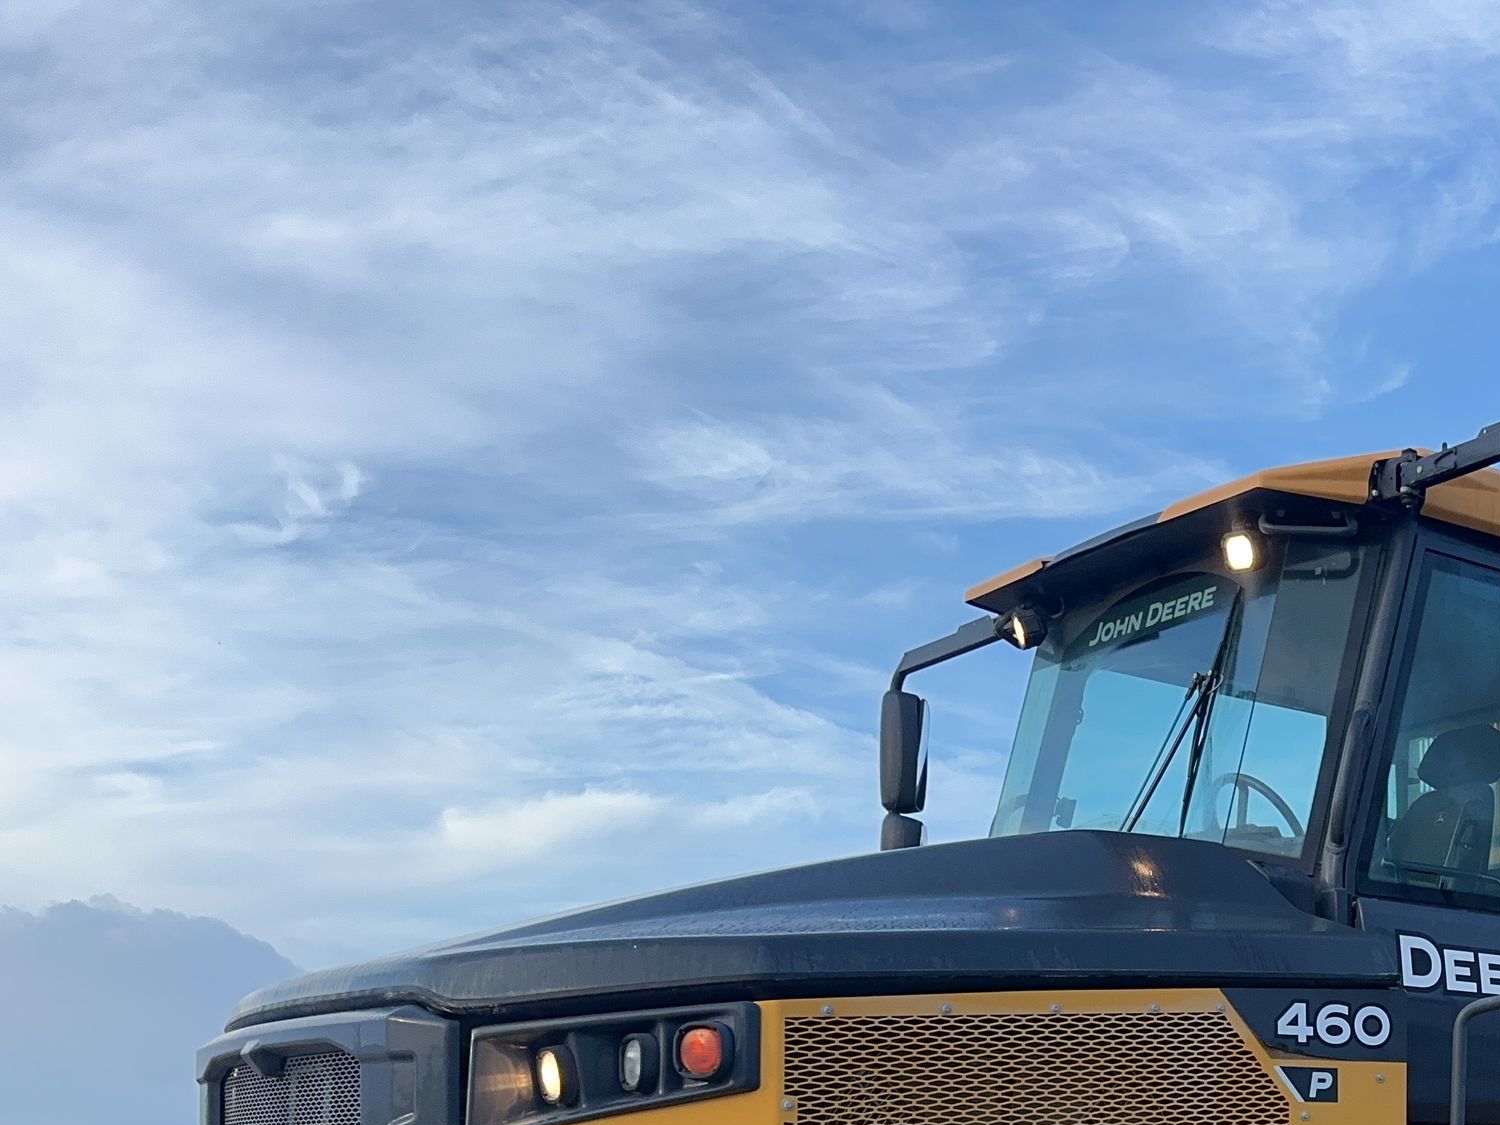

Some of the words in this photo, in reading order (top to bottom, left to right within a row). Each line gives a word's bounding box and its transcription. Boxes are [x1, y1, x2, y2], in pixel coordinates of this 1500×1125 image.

[1089, 611, 1143, 647] JOHN
[1146, 586, 1217, 628] DEERE
[1277, 1002, 1391, 1046] 460
[1308, 1071, 1334, 1098] P
